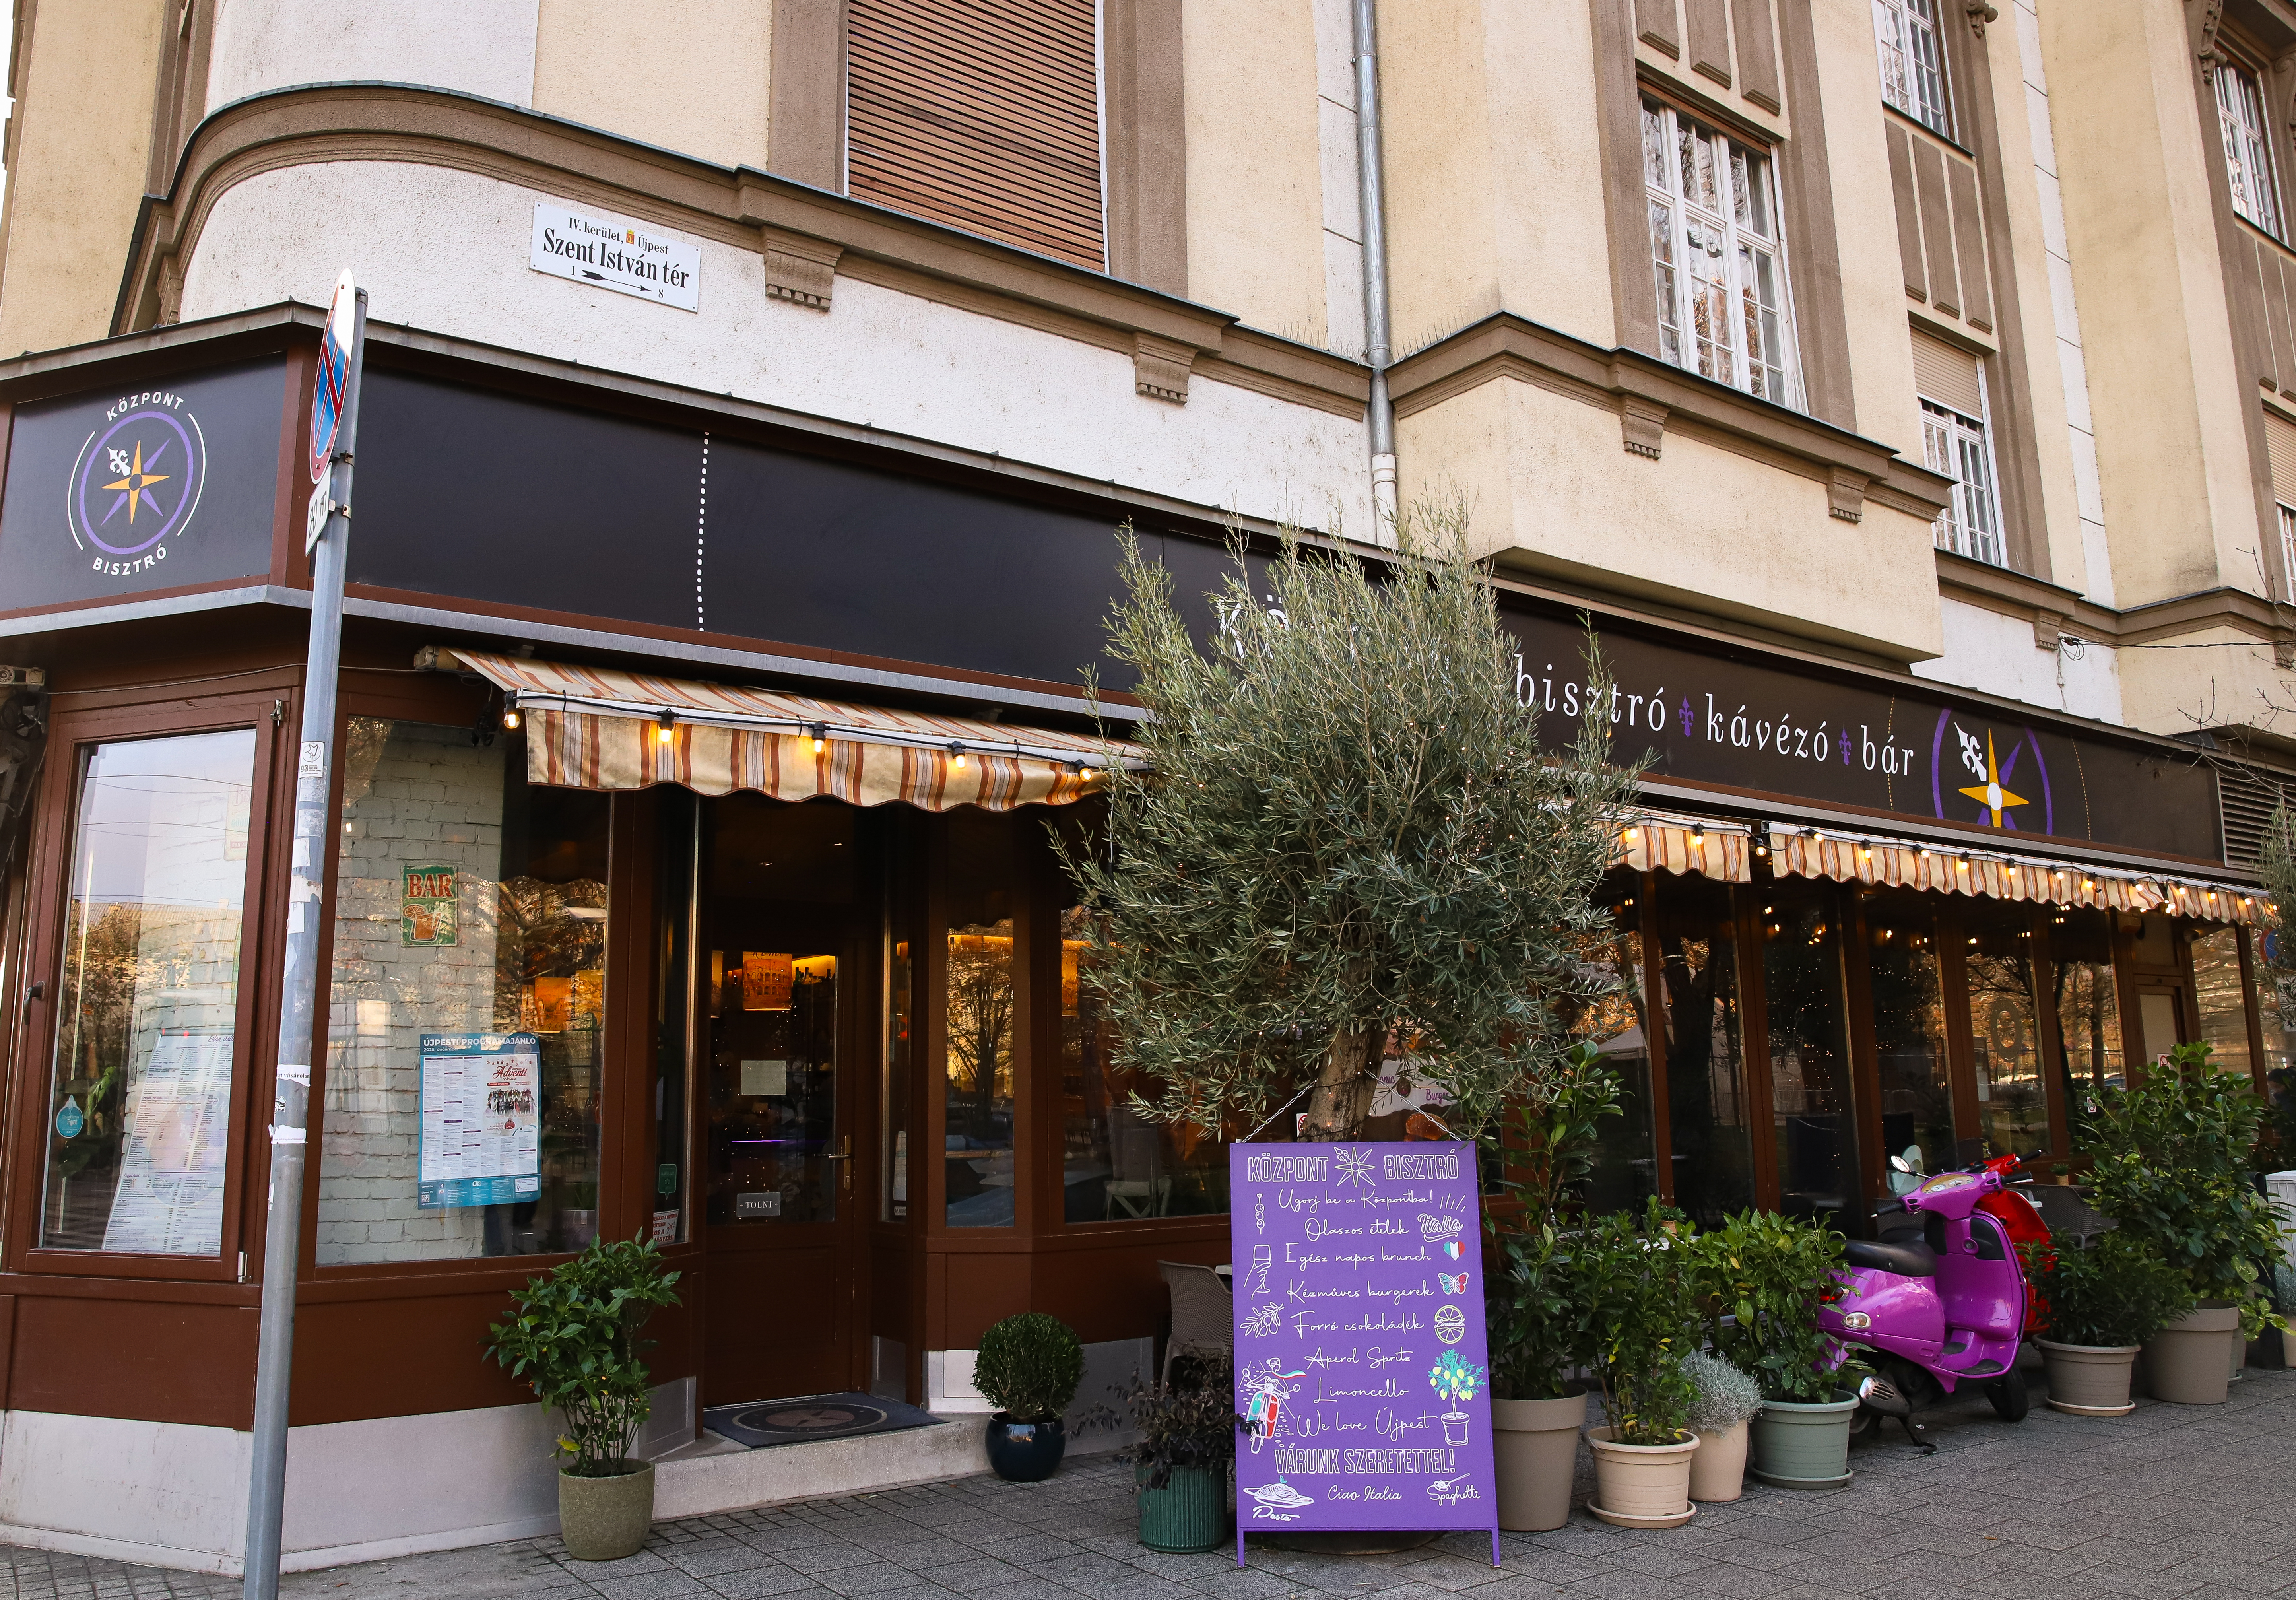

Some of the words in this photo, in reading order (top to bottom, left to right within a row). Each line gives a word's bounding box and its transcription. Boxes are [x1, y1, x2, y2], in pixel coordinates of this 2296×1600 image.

[569, 217, 581, 231] IV.
[584, 222, 624, 244] kerület,
[638, 235, 669, 255] Újpest
[543, 228, 595, 264] Szent
[601, 242, 657, 281] István
[663, 261, 689, 288] tér
[571, 265, 575, 276] 1
[658, 288, 664, 299] 8
[107, 392, 184, 421] KÖZPONT
[92, 543, 167, 576] BISZTRÓ
[1514, 653, 1666, 732] bisztró
[1706, 693, 1829, 763] kávézó
[1861, 725, 1914, 776] bár
[408, 874, 452, 897] BAR
[423, 1037, 458, 1046] ÚJPESTI
[461, 1036, 536, 1045] PROGRAMAJÁNLÓ
[493, 1065, 528, 1079] Adventi
[1247, 1153, 1328, 1182] KÖZPONT
[1384, 1149, 1459, 1180] BISZTRÓ
[1278, 1188, 1321, 1213] Ugorj
[1325, 1190, 1341, 1204] be
[1360, 1188, 1433, 1211] Központba!
[1304, 1217, 1363, 1242] Olaszos
[1369, 1218, 1409, 1235] ételek
[1417, 1213, 1464, 1233] Italia
[1285, 1242, 1328, 1271] Egész
[1335, 1254, 1374, 1270] napos
[1381, 1245, 1432, 1262] brunch
[1287, 1279, 1361, 1305] Kézműves
[1367, 1280, 1434, 1305] burgerek
[1290, 1310, 1339, 1339] Forró
[1344, 1312, 1425, 1334] csokoládék
[1304, 1347, 1360, 1370] Aperol
[1367, 1347, 1413, 1370] Spritz
[1313, 1377, 1409, 1403] Limoncello
[1296, 1408, 1330, 1437] We
[1335, 1412, 1367, 1431] love
[1375, 1406, 1438, 1441] Újpest
[1274, 1443, 1340, 1474] VÁRUNK
[1344, 1449, 1456, 1474] SZERETETTEL!
[1328, 1485, 1360, 1501] Ciao
[1363, 1485, 1402, 1501] Italia
[1427, 1485, 1481, 1506] Spaghetti
[1252, 1505, 1301, 1522] Pasta
